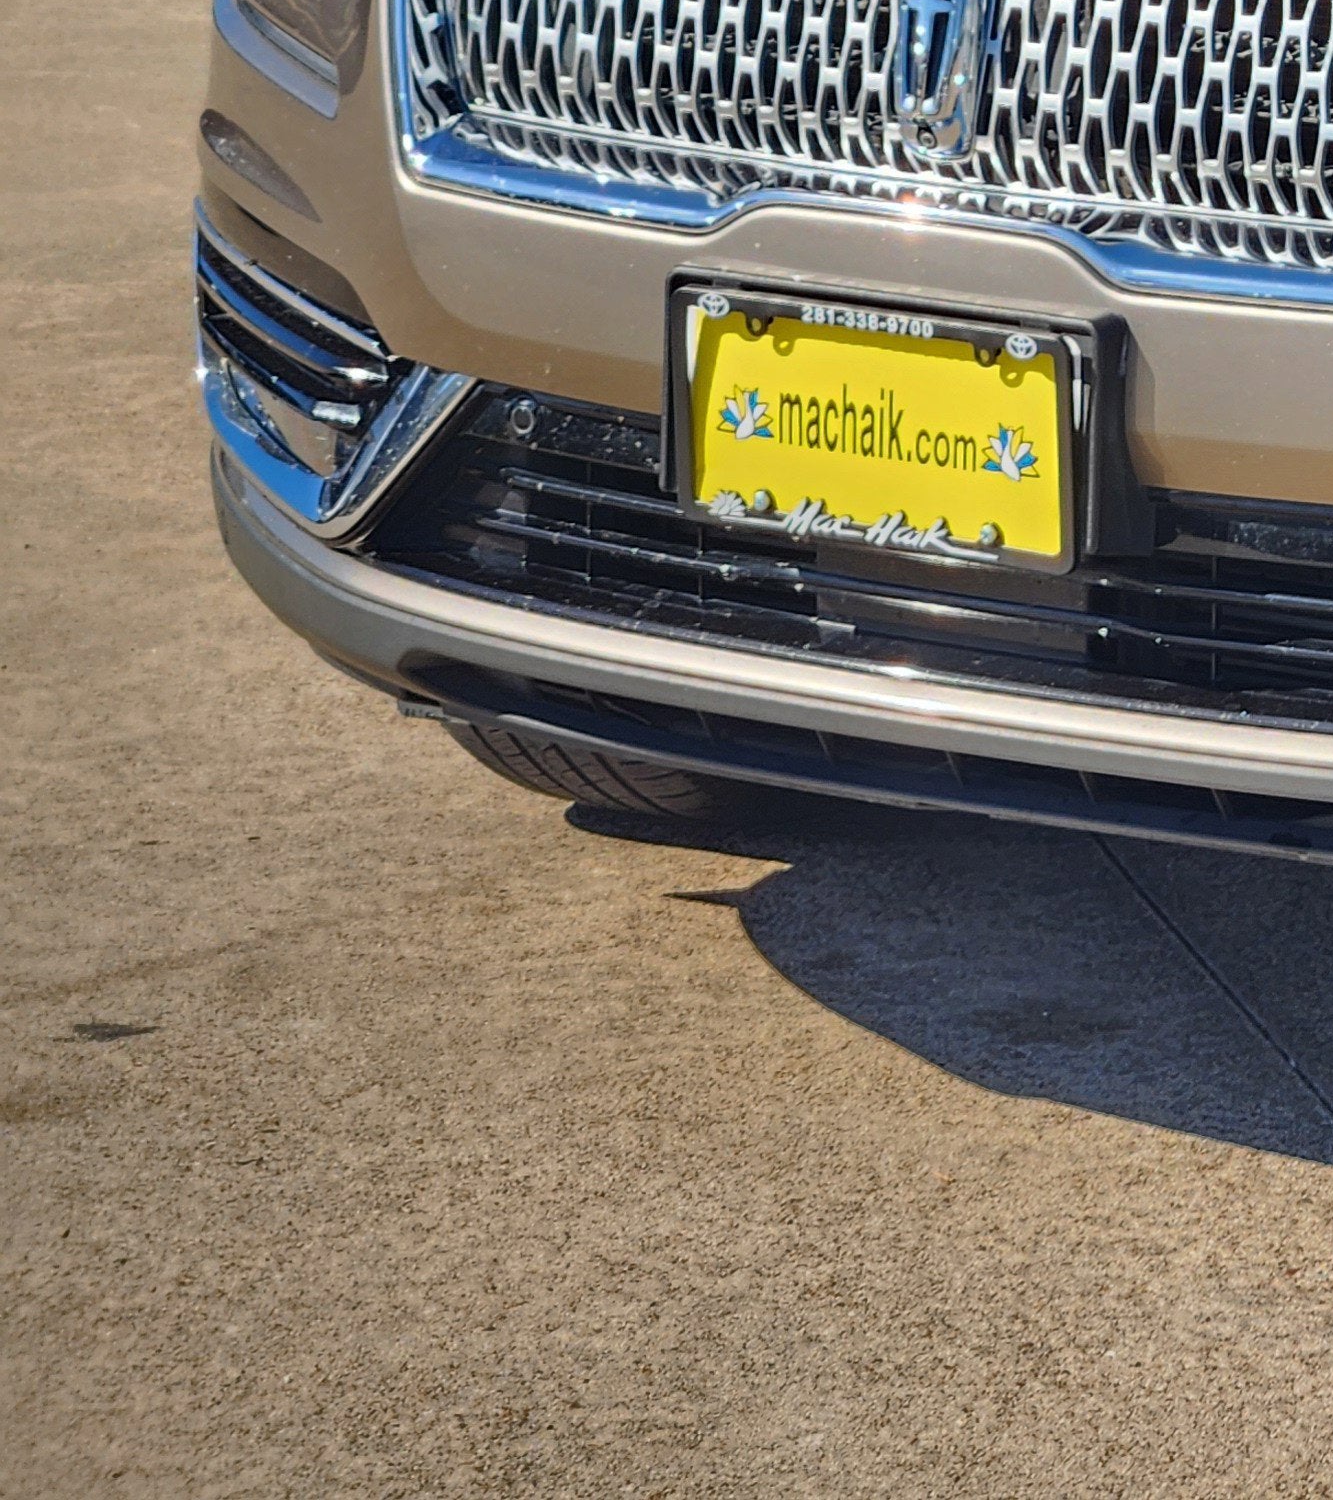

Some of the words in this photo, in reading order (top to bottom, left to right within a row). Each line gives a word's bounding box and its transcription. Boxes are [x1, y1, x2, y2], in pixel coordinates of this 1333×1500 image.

[801, 305, 935, 339] 281-338-9700
[779, 383, 977, 472] machaik.com
[785, 497, 864, 537] Mac
[863, 511, 968, 554] Haik
